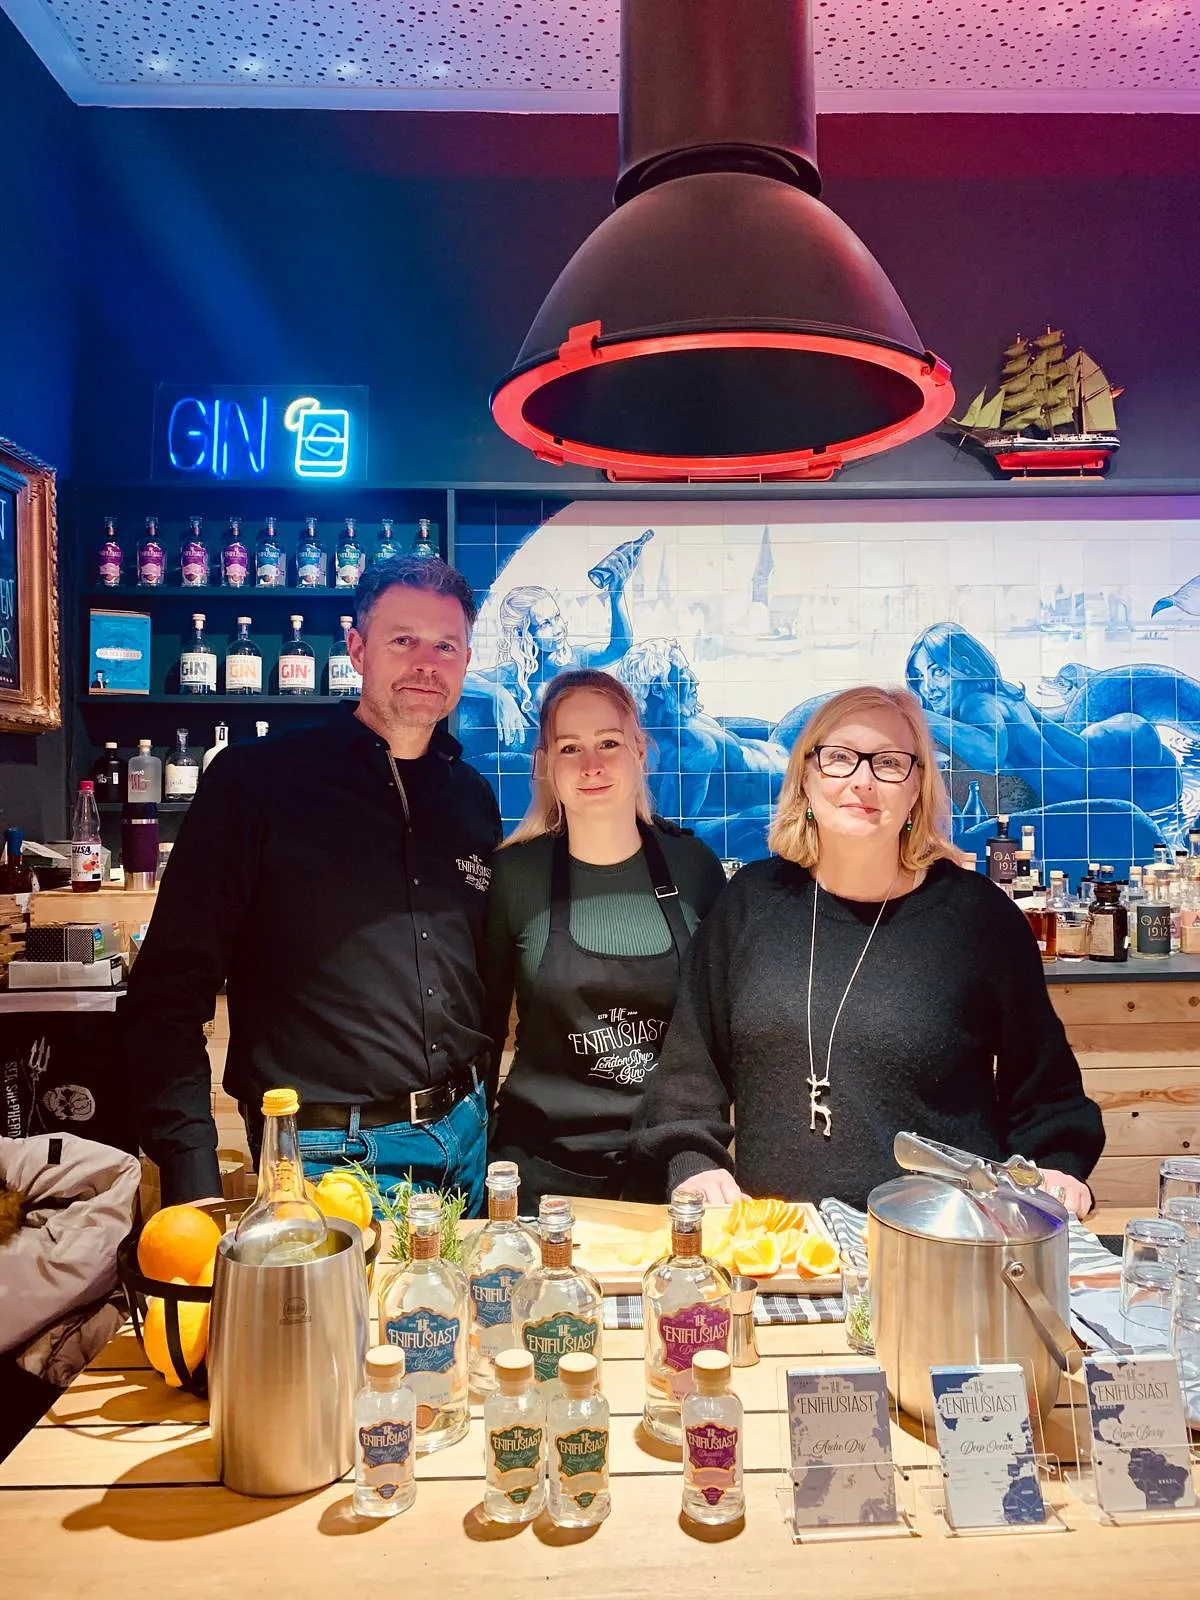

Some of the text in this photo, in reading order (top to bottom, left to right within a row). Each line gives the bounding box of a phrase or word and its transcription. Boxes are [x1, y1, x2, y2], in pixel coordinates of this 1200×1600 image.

[167, 396, 268, 477] GIN
[181, 661, 207, 676] GIN
[230, 663, 257, 678] GIN
[281, 664, 308, 679] GIN
[993, 851, 1016, 861] OAT
[455, 858, 492, 879] ENTHUSIAS
[1147, 926, 1169, 937] 1912
[609, 1007, 627, 1023] THE
[567, 1018, 668, 1055] ENTHUSIAST
[590, 1053, 632, 1072] London
[615, 1065, 646, 1085] Gin
[6, 1083, 22, 1137] SHEPHERD
[472, 1285, 512, 1303] ENTHUS
[388, 1323, 458, 1349] ENTHUSIAST
[526, 1329, 597, 1354] ENTHUSIAST
[662, 1319, 729, 1344] ENTHUSIAST
[1094, 1382, 1170, 1402] ENTHUSIAST
[797, 1394, 876, 1415] ENTHUSIAST
[941, 1394, 1019, 1415] ENTHUSIAST
[361, 1426, 412, 1447] ENTHUSIAST
[492, 1430, 542, 1451] ENTHUSIAST
[558, 1434, 608, 1456] ENTHUSIAST
[686, 1431, 737, 1450] ENTHUSIAST
[844, 1438, 867, 1454] Dry
[960, 1440, 1013, 1456] Deep Ocean
